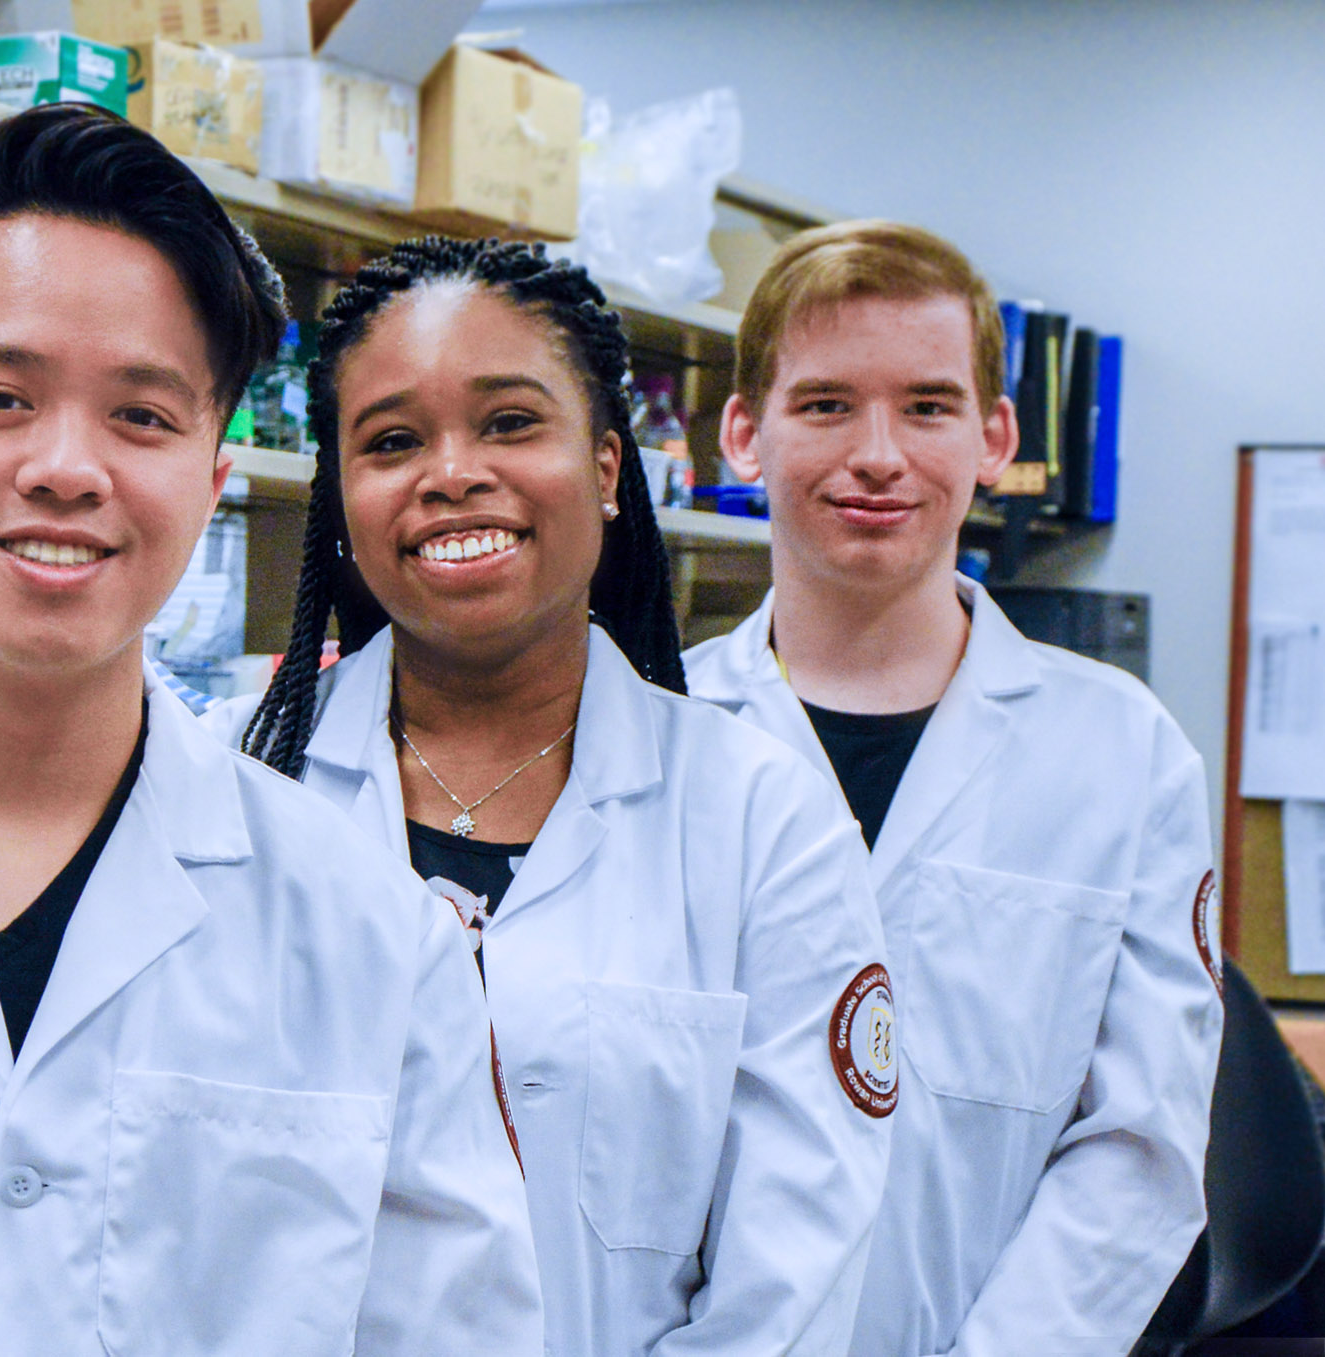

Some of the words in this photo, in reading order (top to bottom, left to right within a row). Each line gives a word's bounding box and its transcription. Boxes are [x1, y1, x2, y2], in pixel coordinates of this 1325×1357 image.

[836, 995, 858, 1049] Graduate
[855, 972, 878, 997] School
[844, 1067, 871, 1102] Rowan
